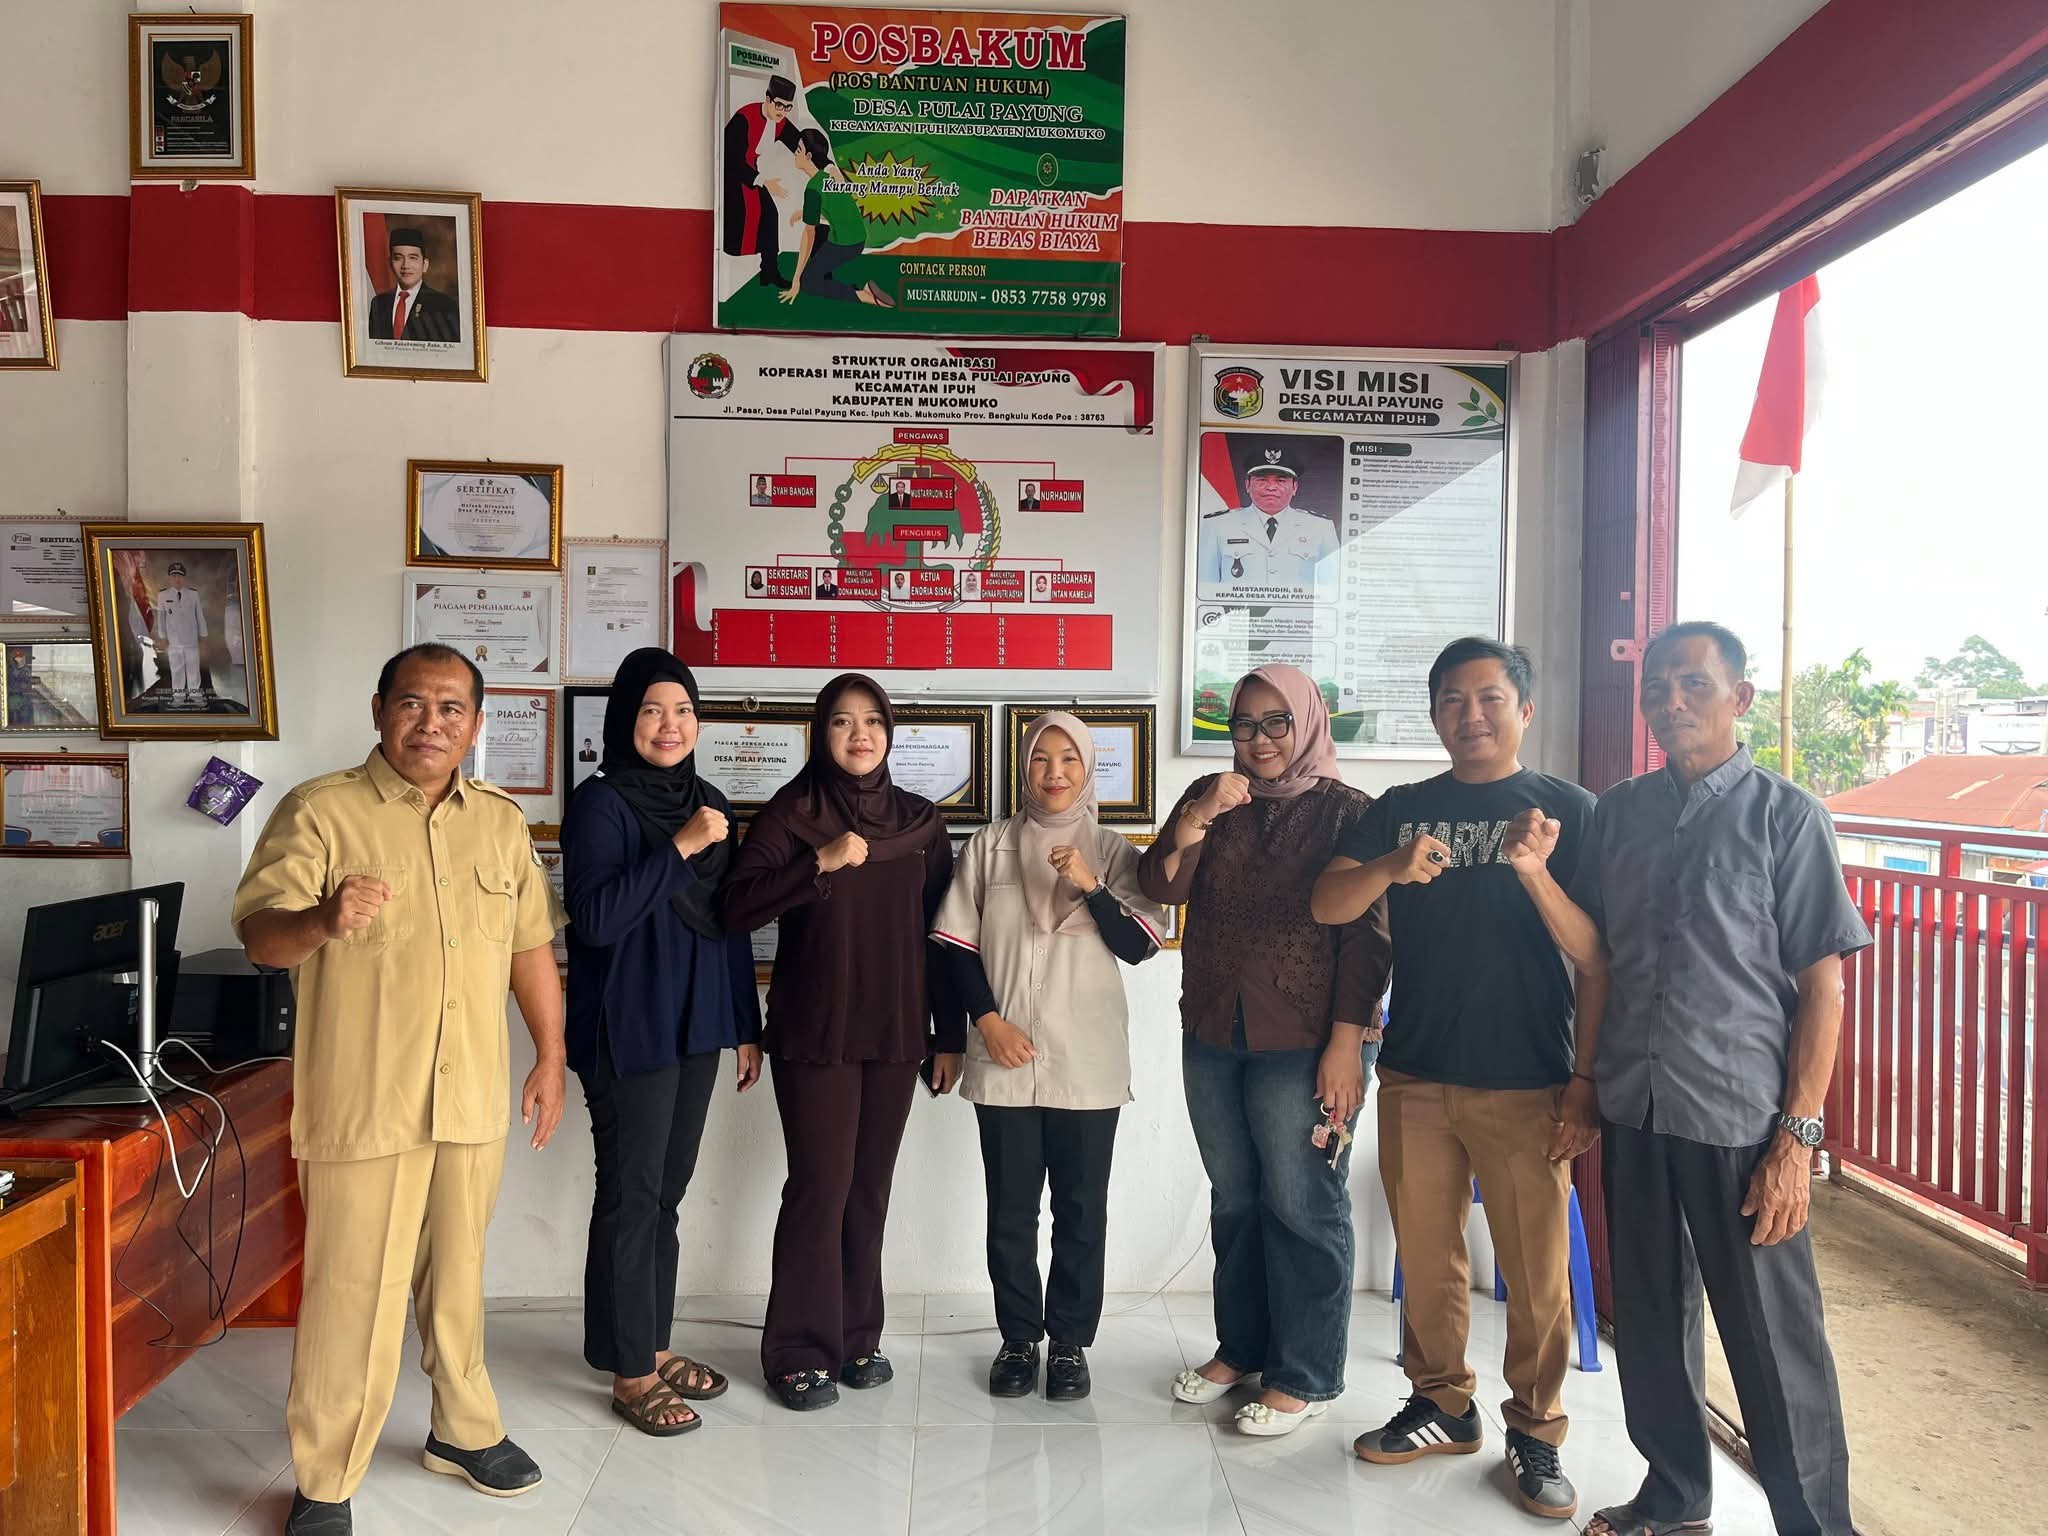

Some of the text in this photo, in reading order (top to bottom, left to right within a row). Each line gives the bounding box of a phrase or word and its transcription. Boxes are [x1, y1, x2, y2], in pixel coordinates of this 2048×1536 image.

[812, 23, 1086, 70] POSBAKUM
[736, 50, 780, 66] POSBAKUM
[830, 73, 1050, 98] (POS BANTUAN HUKUM)
[854, 99, 1083, 122] DESA PULAI PAYUNG
[830, 120, 1105, 140] KECAMATAN IPUH KABUPATEN MUKOMUKO
[857, 163, 922, 181] Anda Yang
[822, 179, 960, 199] Kurang Mampu Berhak
[990, 189, 1088, 208] DAPATKAN
[959, 208, 1118, 232] BANTUAN HUKUM
[973, 229, 1101, 252] BEBAS BIAYA
[899, 262, 986, 277] CONTACK PERSON
[906, 289, 978, 302] MUSTARRUDIN
[991, 289, 1027, 304] 0853
[1032, 291, 1067, 306] 7758
[1072, 292, 1107, 307] 9798
[832, 355, 995, 369] STRUKTUR ORGANISASI
[759, 367, 1071, 384] KOPERASI MERAH PUTIH DESA PULAI PAYUNG
[1280, 368, 1429, 394] VISI MISI
[855, 383, 976, 394] KECAMATAN IPUH
[832, 396, 998, 408] KABUPATEN MUKOMUKO
[1279, 393, 1443, 409] DESA PULAI PAYUNG
[766, 407, 787, 415] Desa
[815, 408, 847, 418] Payung
[850, 409, 869, 417] Kec.
[871, 409, 890, 418] Ipuh
[893, 410, 913, 418] Kab.
[915, 411, 962, 419] Mukomuko
[964, 412, 986, 420] Prov.
[988, 412, 1029, 421] Bengkulu
[1031, 413, 1053, 421] Kode
[1056, 413, 1072, 421] Pos
[1080, 413, 1105, 421] 38763
[1293, 411, 1426, 424] KECAMATAN IPUH
[898, 432, 944, 440] PENGAWAS
[1356, 445, 1377, 453] MISI
[457, 486, 516, 495] SERTIFIKAT
[773, 487, 814, 497] SYAH BANDAR
[1040, 491, 1082, 502] NURHADIMIN
[900, 529, 941, 537] PENGURUS
[768, 569, 809, 579] SEKRETARIS
[920, 572, 940, 582] KETUA
[1052, 573, 1092, 584] BENDAHARA
[767, 585, 810, 596] TRI SUSANTI
[853, 588, 878, 596] MANDALA
[935, 587, 952, 596] SISKA
[1052, 589, 1093, 599] INTAN KAMELIA
[434, 603, 533, 611] PIAGAM PENGHARGAAN
[497, 710, 537, 719] PIAGAM
[758, 756, 787, 764] PAYUNG
[94, 919, 128, 942] acer
